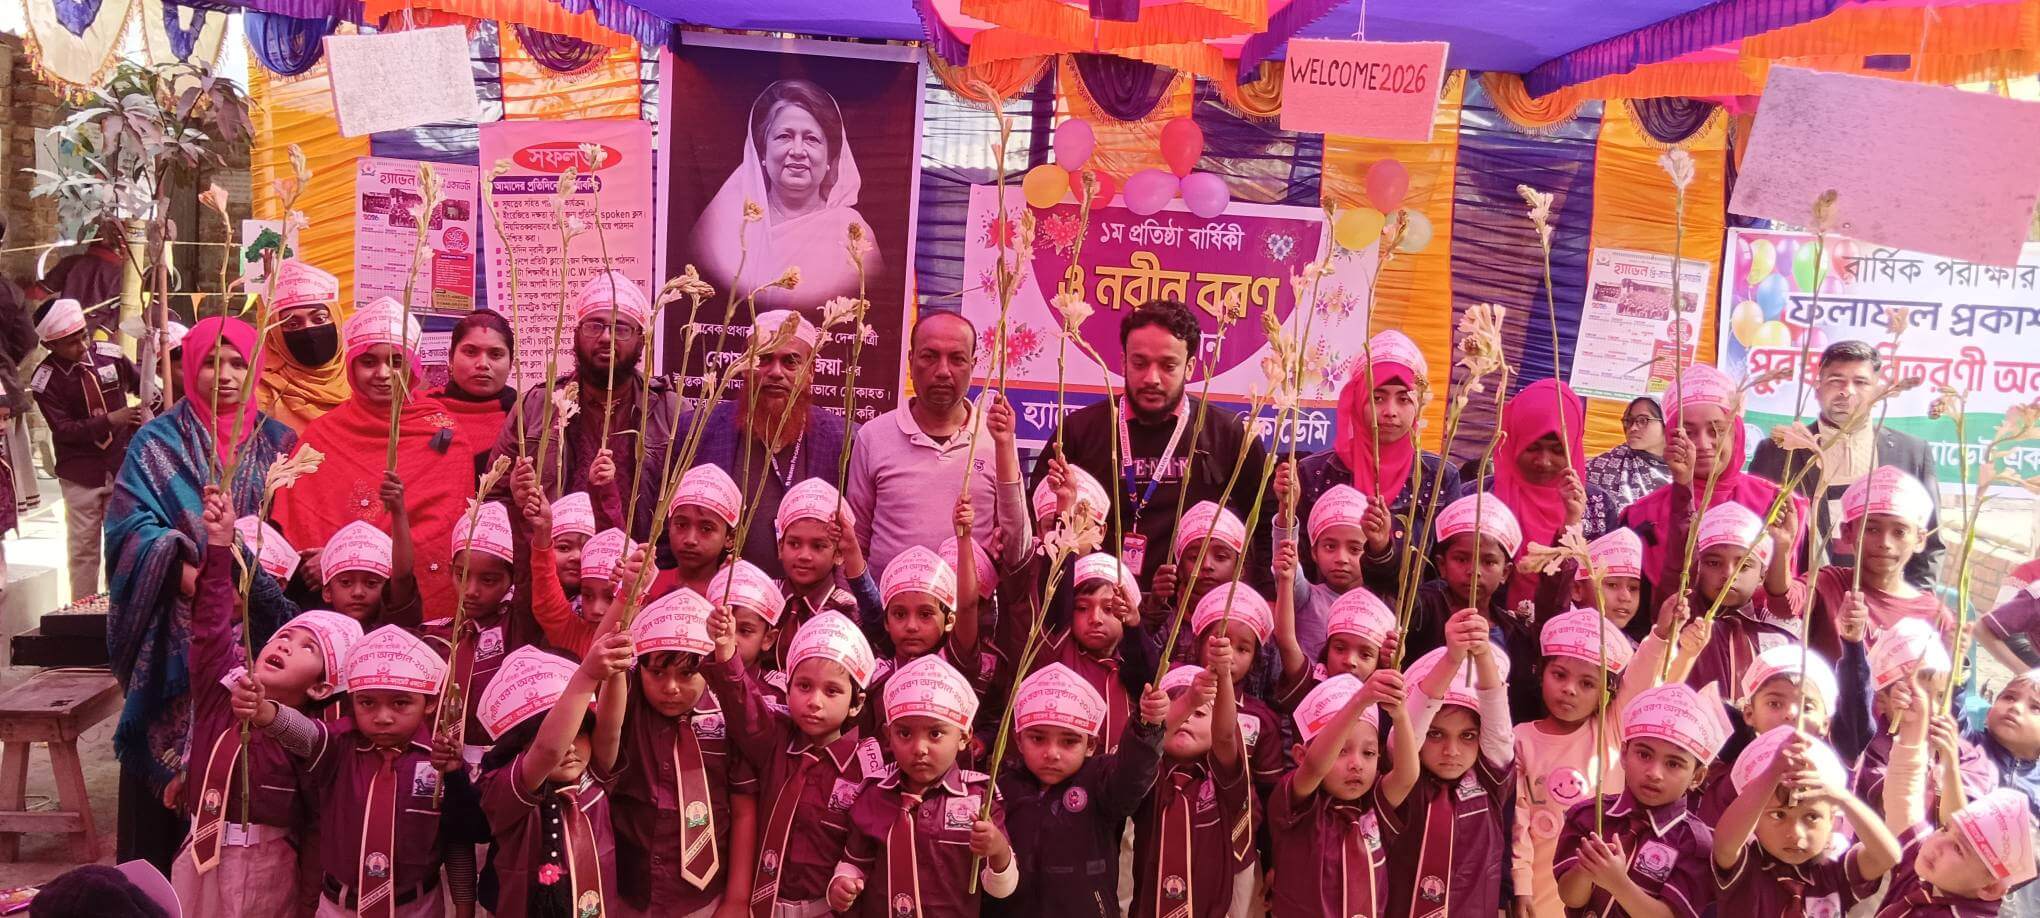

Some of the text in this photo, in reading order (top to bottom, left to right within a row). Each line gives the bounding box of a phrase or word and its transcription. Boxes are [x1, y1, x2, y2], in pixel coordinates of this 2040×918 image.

[526, 147, 603, 171] সফলত
[601, 209, 630, 221] spoken
[1100, 217, 1246, 252] ১ম প্রতিষ্ঠা বার্ষিকী
[1842, 248, 1924, 284] বার্ষিক
[1094, 250, 1192, 312] নবীন
[1195, 272, 1281, 320] বরণ
